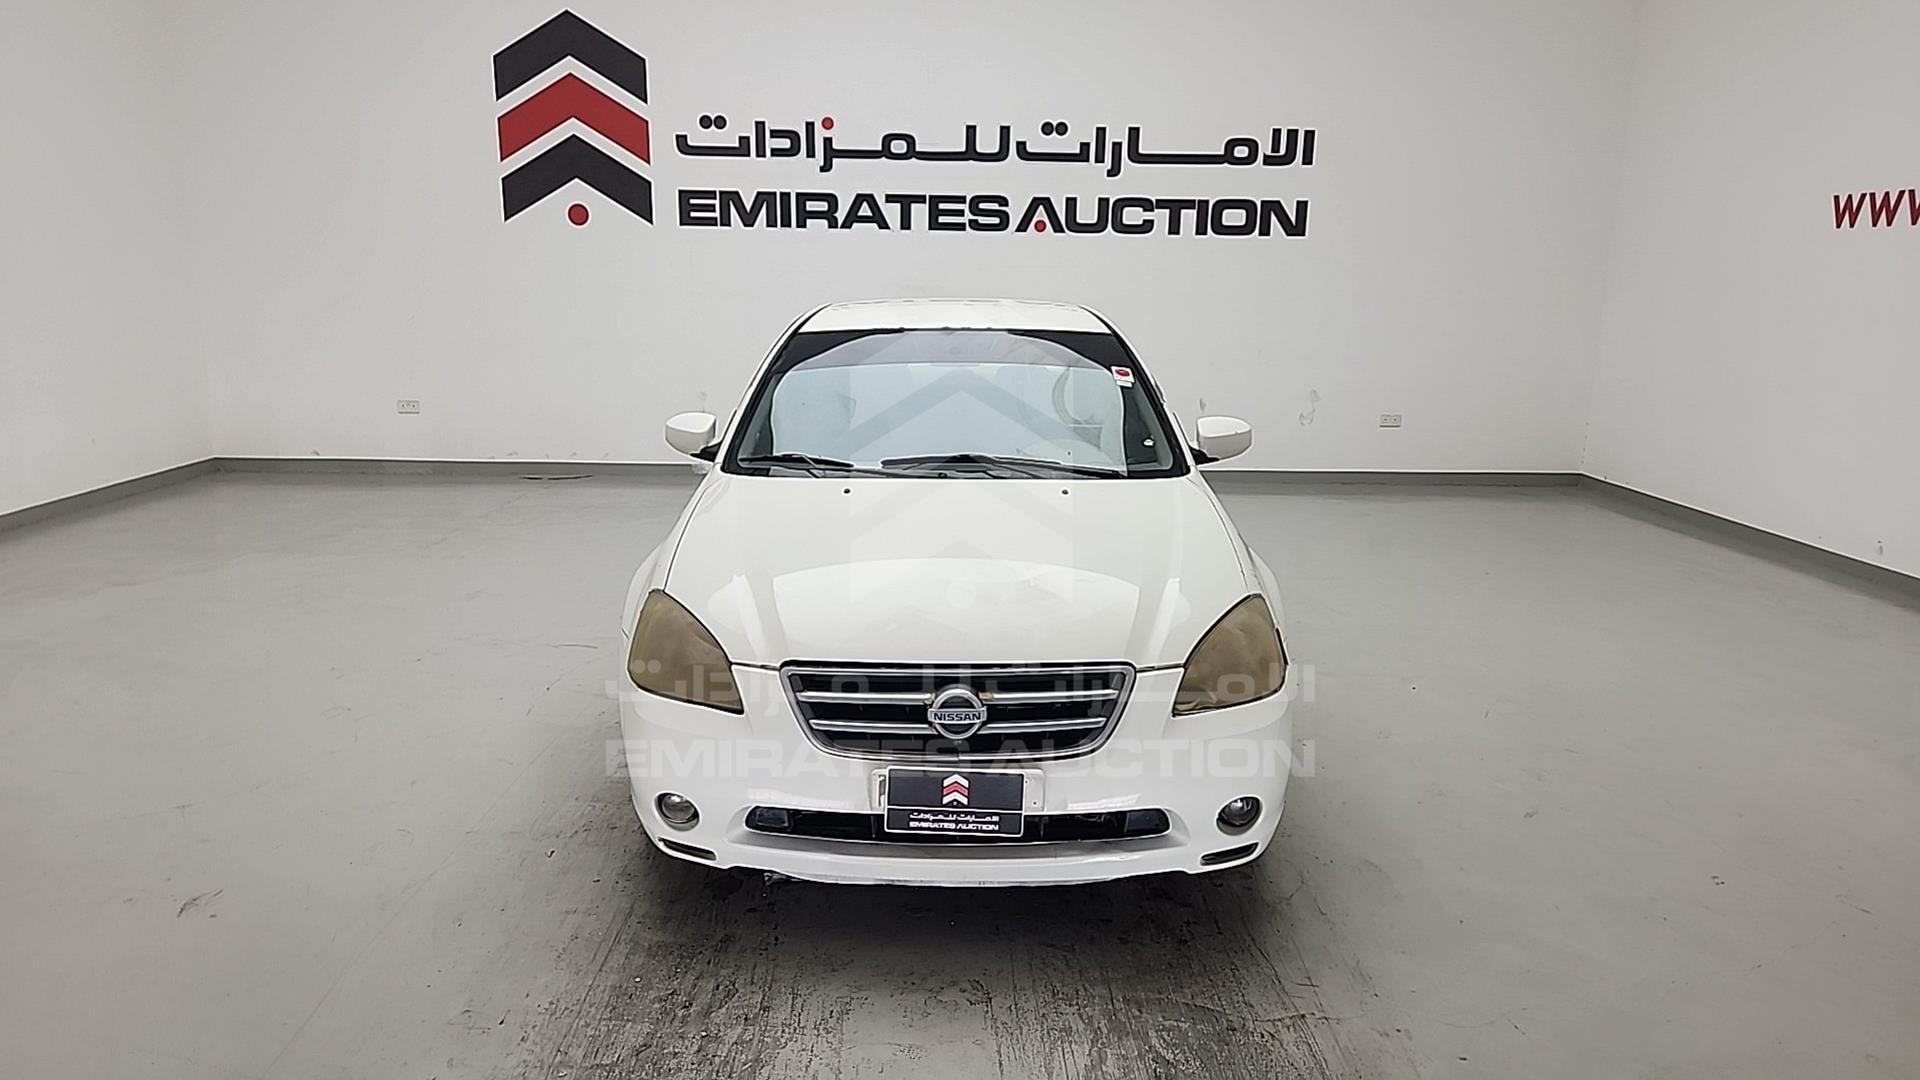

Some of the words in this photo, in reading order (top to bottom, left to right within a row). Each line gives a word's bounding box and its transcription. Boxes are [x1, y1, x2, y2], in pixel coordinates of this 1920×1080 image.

[674, 114, 1011, 173] للمزادات
[1015, 120, 1316, 178] الامارات
[677, 188, 1010, 233] EMIRATES
[1013, 196, 1309, 237] AUCTION
[933, 711, 981, 721] NISSAN
[909, 821, 956, 829] EMIRATES
[956, 823, 999, 831] AUCTION
